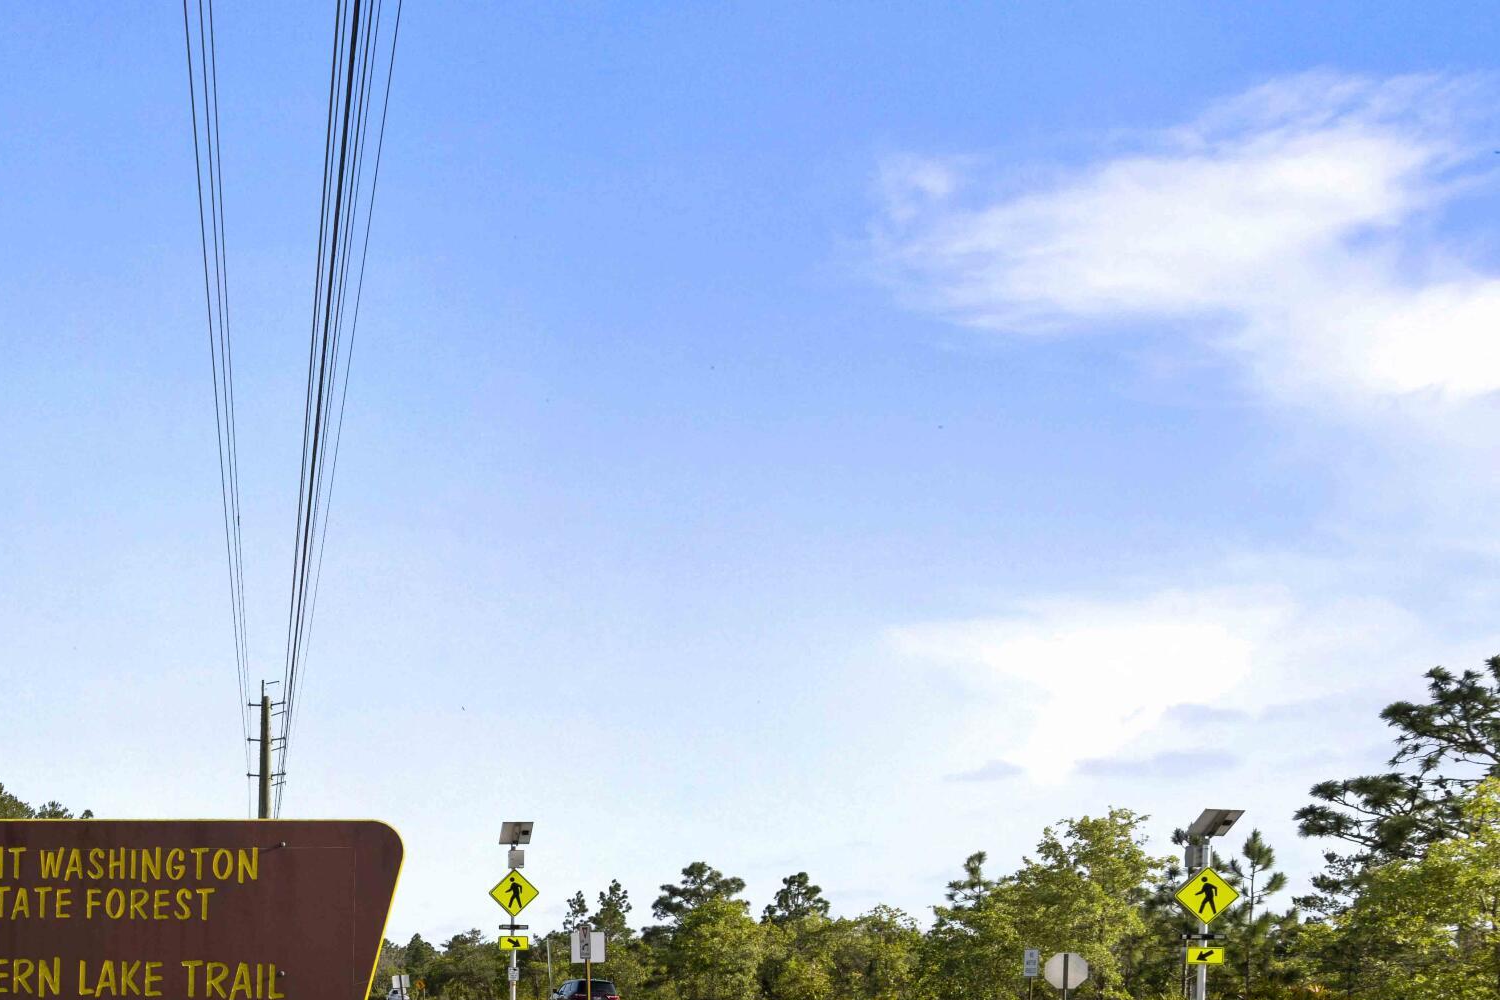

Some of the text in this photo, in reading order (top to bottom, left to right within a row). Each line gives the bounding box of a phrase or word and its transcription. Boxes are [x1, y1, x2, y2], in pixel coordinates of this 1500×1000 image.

[40, 847, 259, 884] WASHINGTON
[86, 887, 215, 921] FOREST
[78, 960, 163, 998] LAKE
[181, 960, 285, 1000] TRAIL
